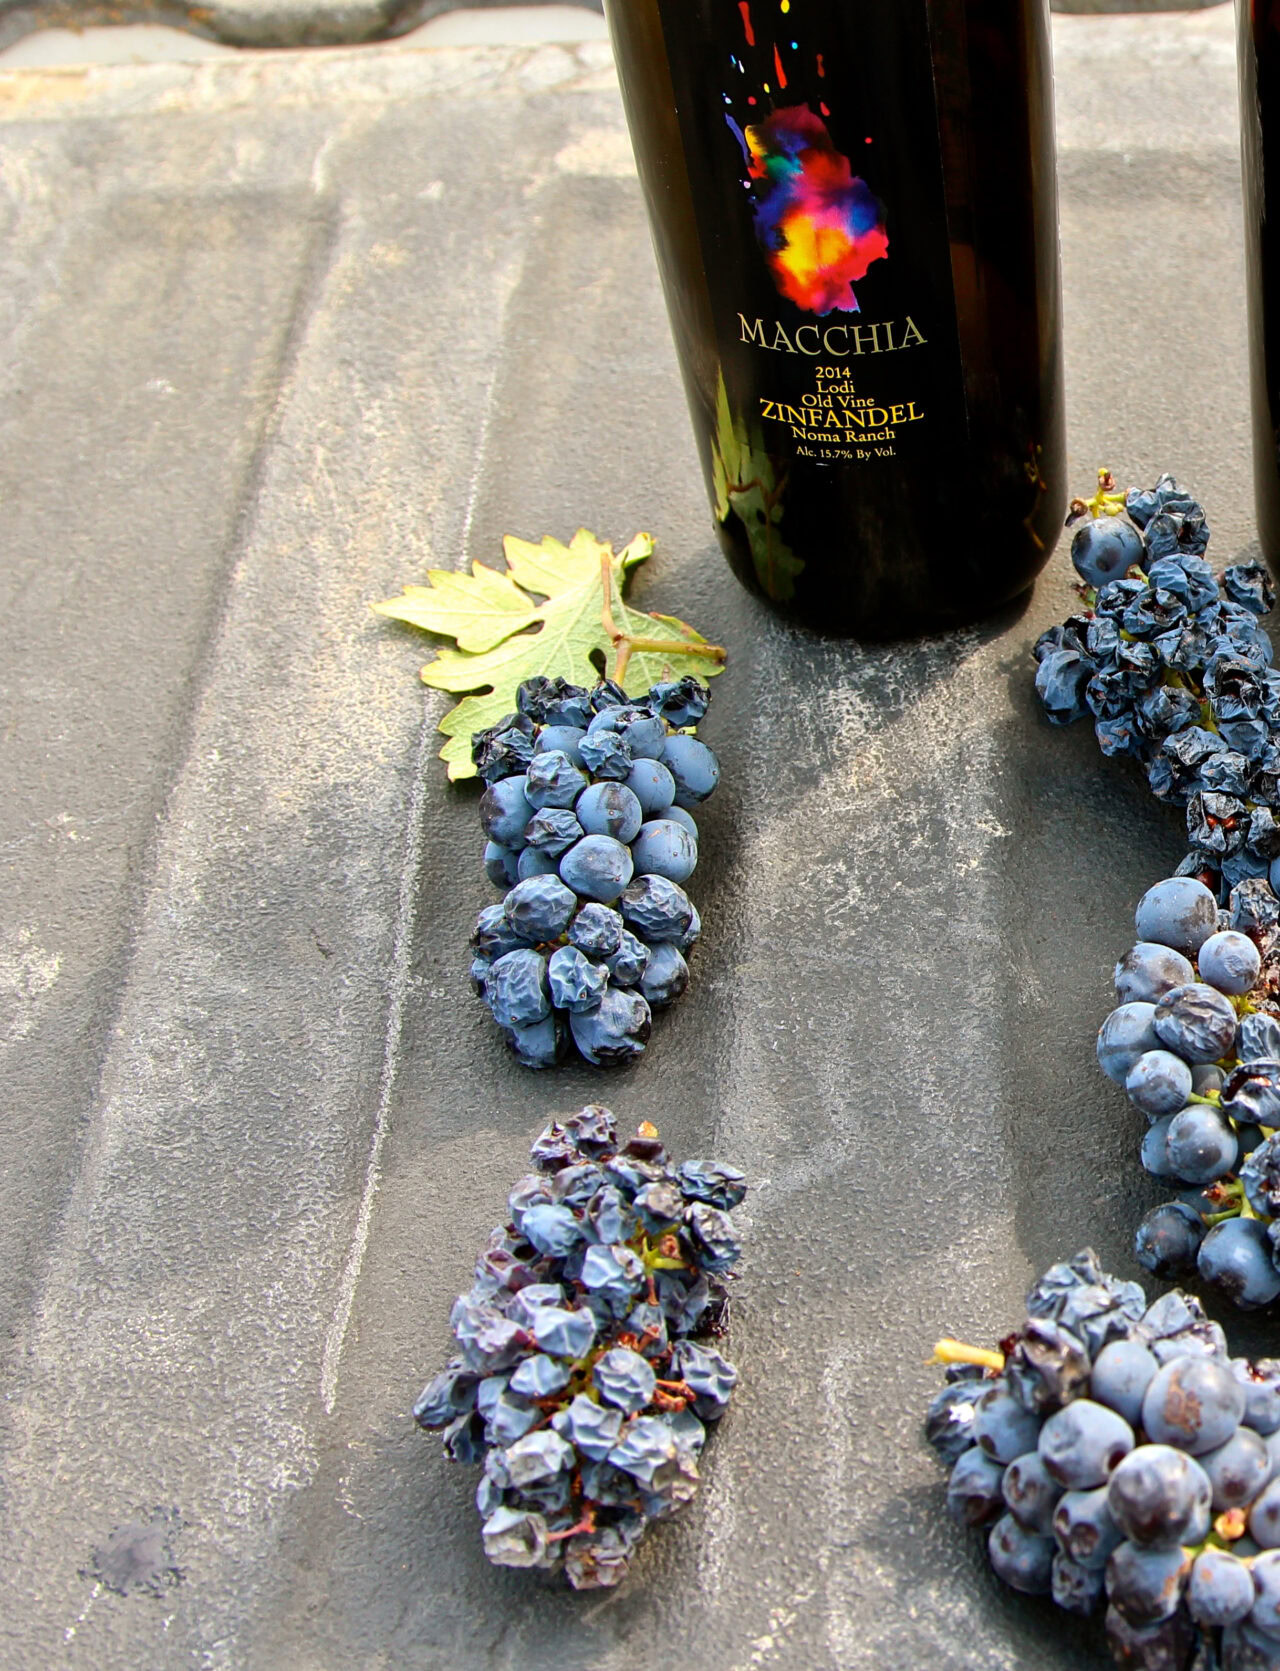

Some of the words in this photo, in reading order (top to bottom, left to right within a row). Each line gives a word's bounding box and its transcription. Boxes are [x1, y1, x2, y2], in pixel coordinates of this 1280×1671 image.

[736, 312, 928, 356] MACCHIA
[815, 366, 851, 379] 2014
[816, 380, 855, 393] Lodi
[801, 393, 833, 408] Old
[837, 395, 875, 407] Vine
[759, 397, 925, 428] ZINFANDEL
[790, 425, 841, 442] Noma
[844, 426, 896, 442] Ranch
[796, 446, 817, 457] Alc.
[820, 449, 853, 459] 15.7%
[857, 449, 870, 461] By
[875, 446, 896, 456] Vol.
